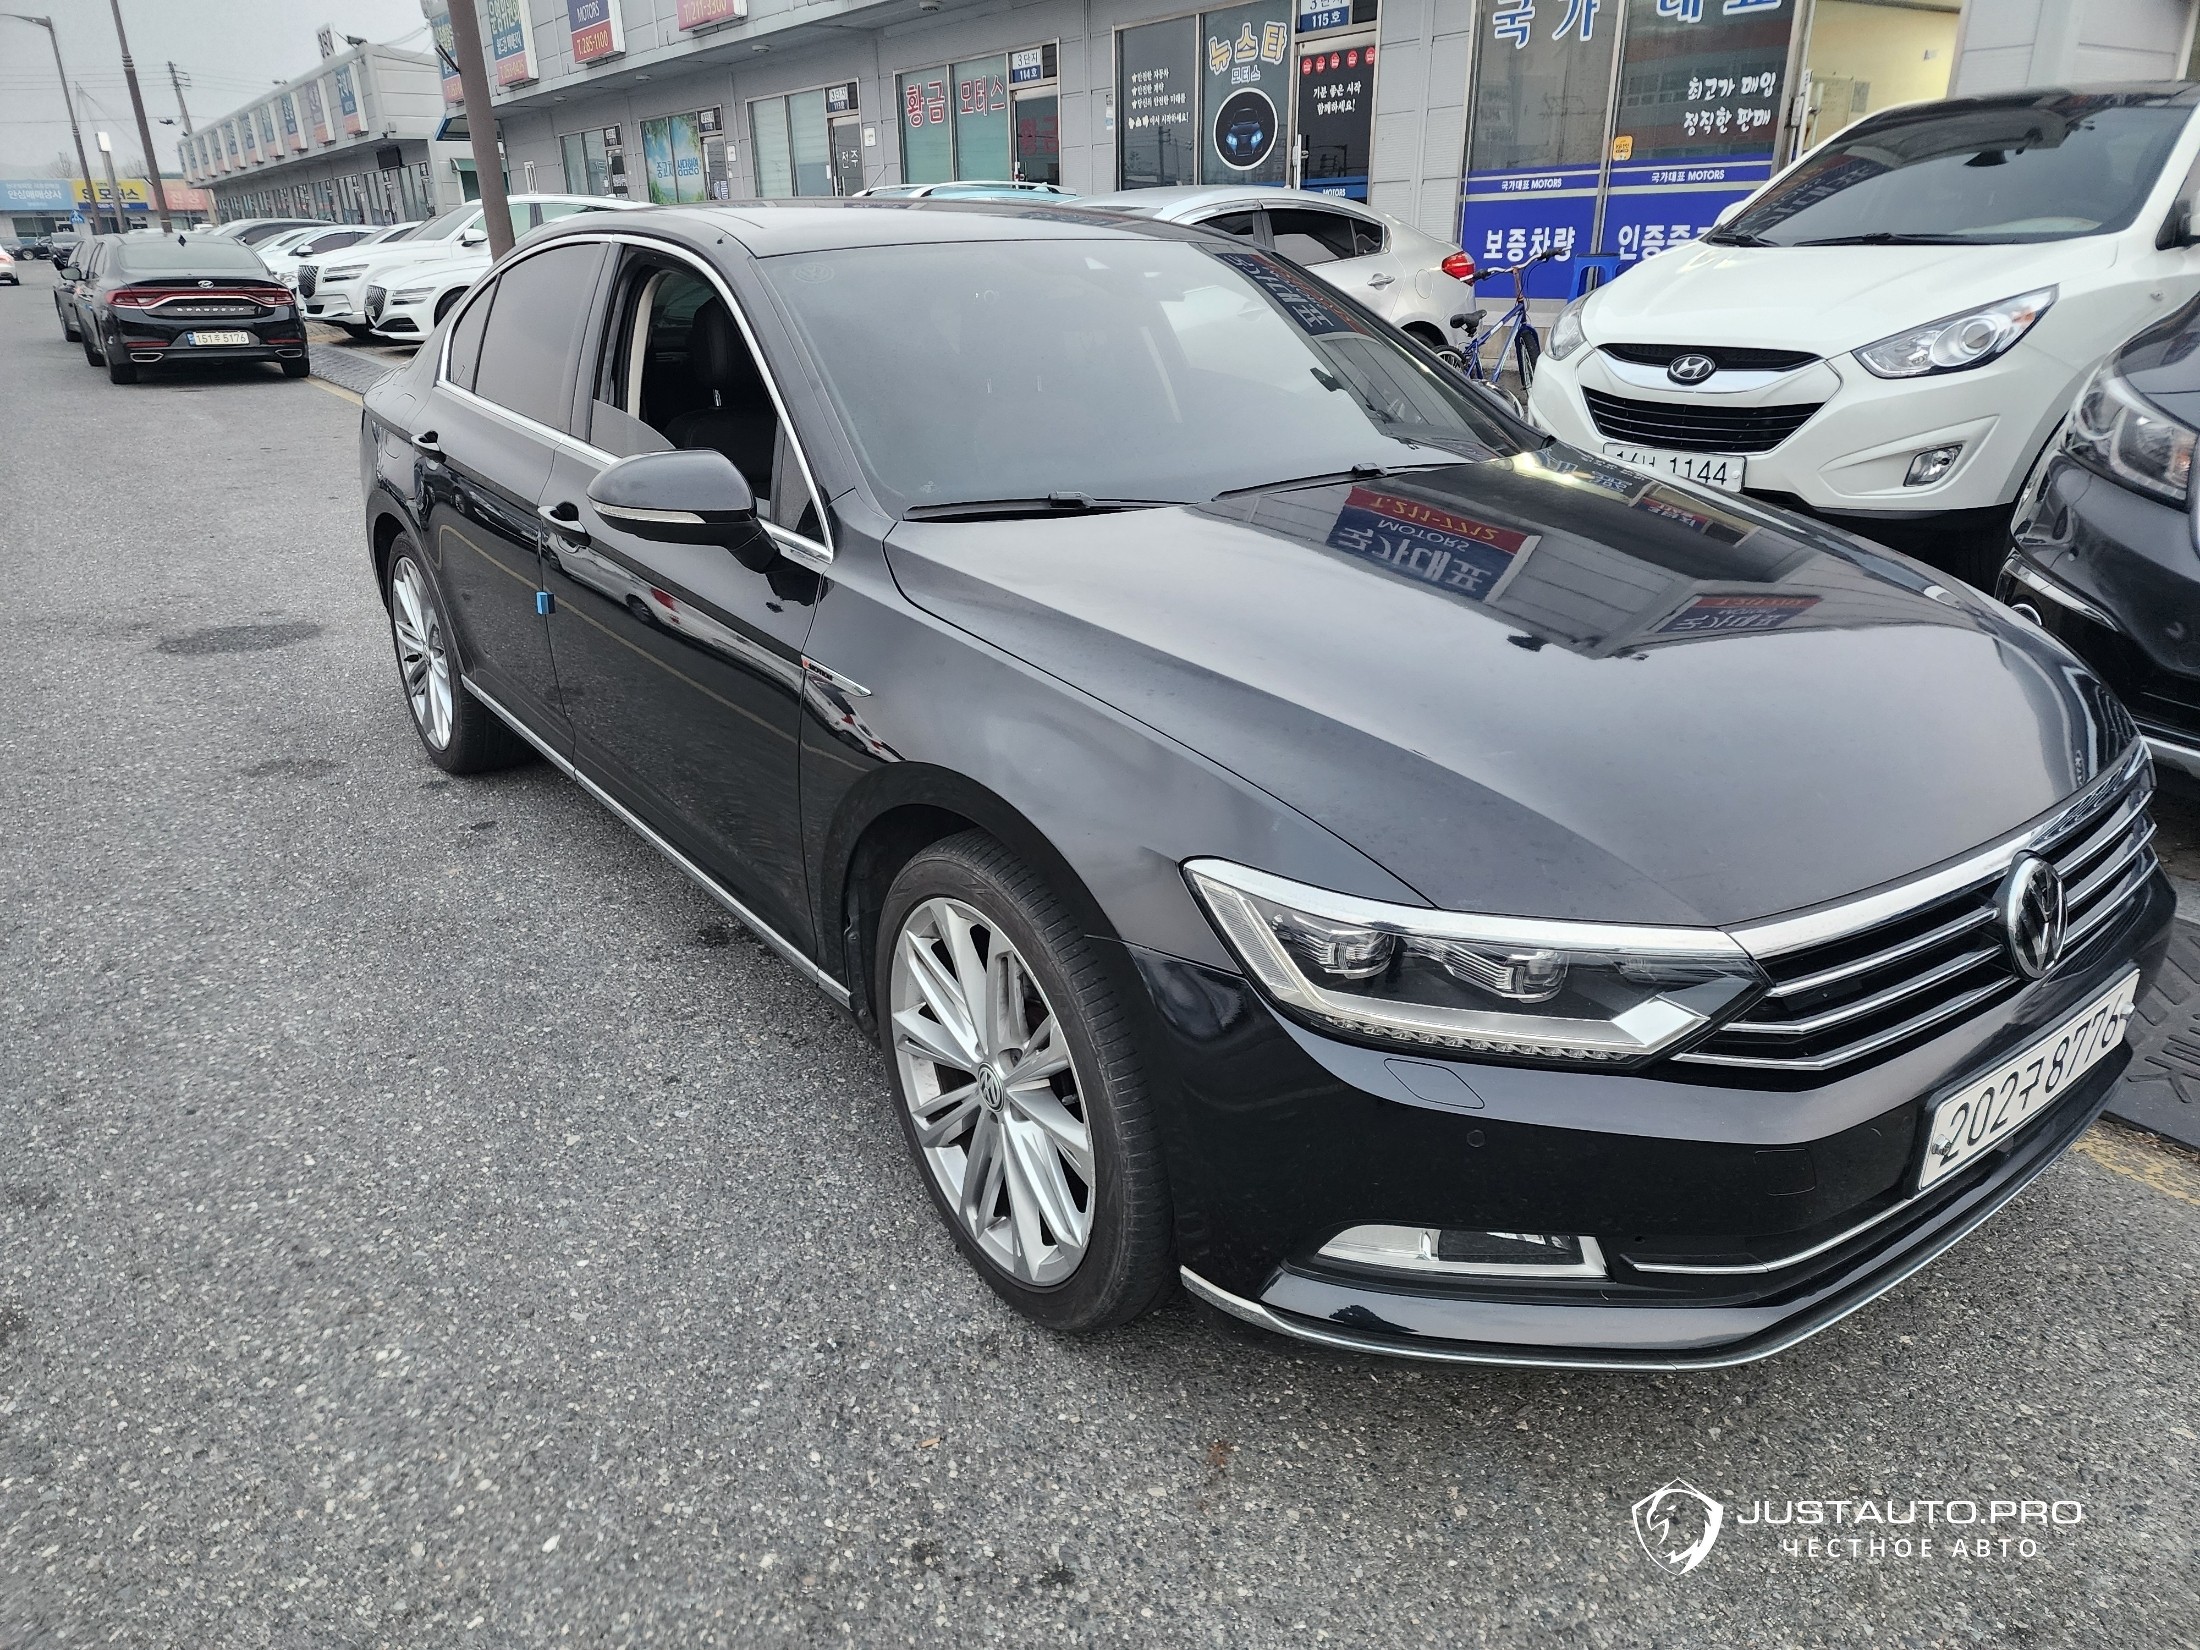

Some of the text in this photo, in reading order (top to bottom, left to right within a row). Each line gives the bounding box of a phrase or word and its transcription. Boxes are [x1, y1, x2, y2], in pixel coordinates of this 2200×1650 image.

[576, 0, 600, 23] MOTORS
[1312, 10, 1341, 28] 115호
[1208, 20, 1288, 75] 뉴스타
[1017, 51, 1038, 67] 3단지
[1019, 67, 1038, 81] 114호
[1231, 64, 1261, 85] 모터스
[1313, 85, 1328, 99] 기분
[1347, 80, 1362, 95] 시작
[1687, 71, 1777, 101] 최고가 매입
[906, 79, 946, 128] 황금
[1317, 98, 1356, 116] 함께하세요!
[1683, 106, 1771, 137] 정직한 판매
[1501, 177, 1562, 192] 국가대표 MOTORS
[1651, 169, 1725, 183] 국가대표 MOTORS
[1322, 188, 1346, 197] MOTORS
[1483, 226, 1576, 263] 보증차량
[1669, 456, 1728, 486] 1144
